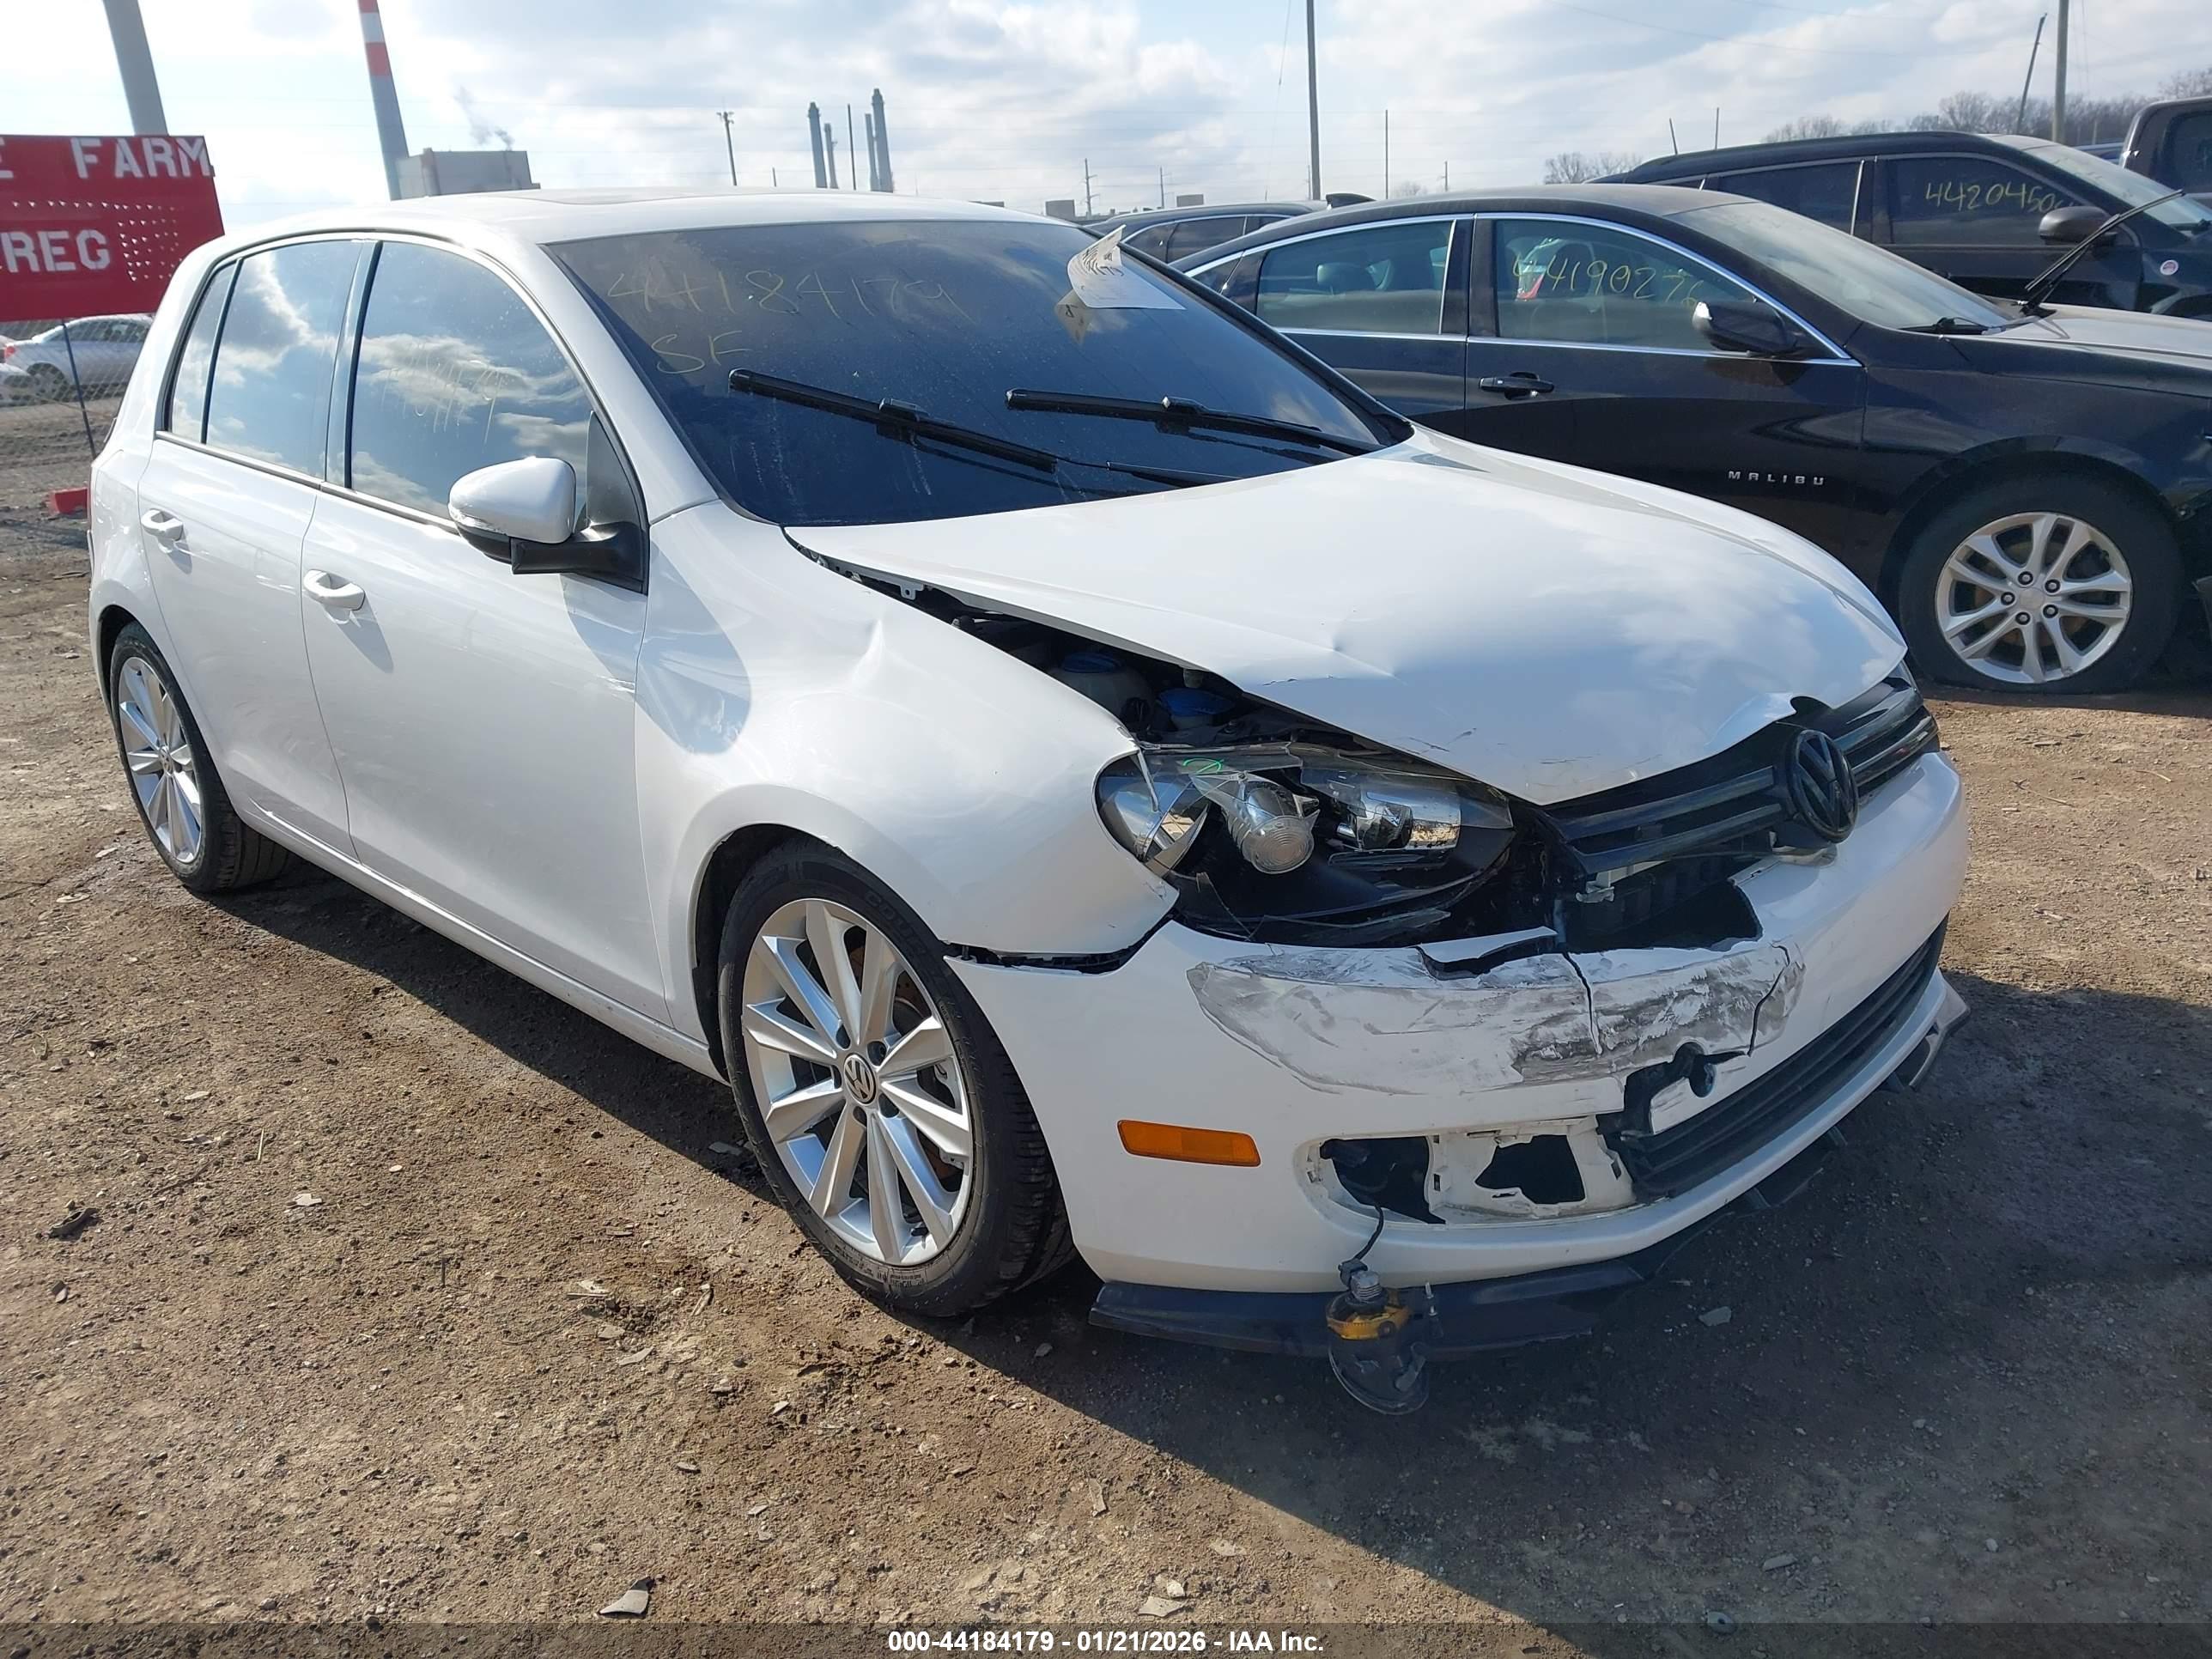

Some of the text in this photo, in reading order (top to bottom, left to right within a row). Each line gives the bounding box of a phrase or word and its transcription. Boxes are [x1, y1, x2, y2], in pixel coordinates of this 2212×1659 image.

[70, 137, 211, 179] FARM
[0, 228, 111, 273] REG
[607, 270, 977, 325] 44184179
[1728, 470, 1825, 485] MALIBU
[844, 1054, 875, 1103] VW
